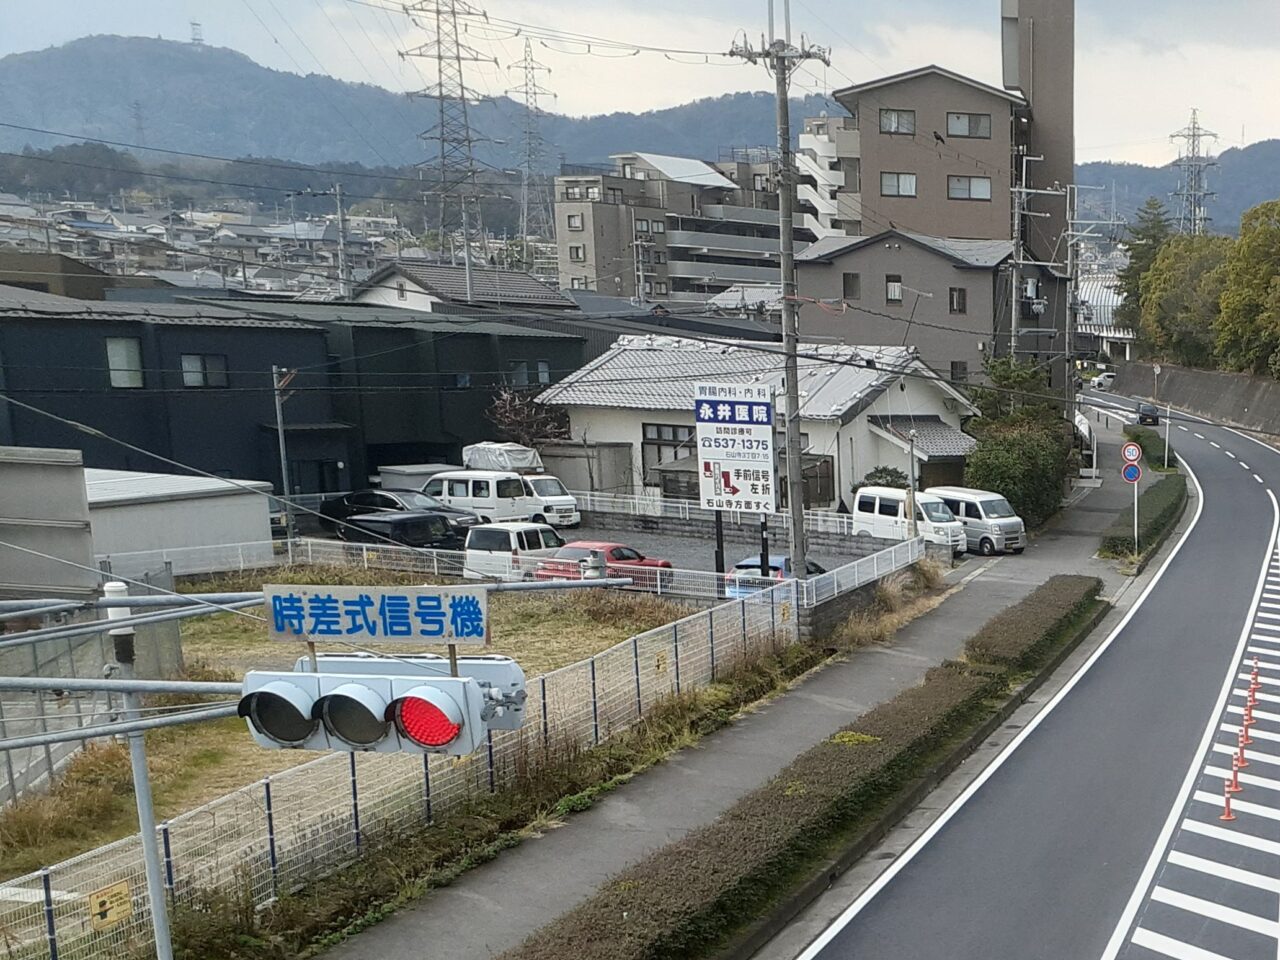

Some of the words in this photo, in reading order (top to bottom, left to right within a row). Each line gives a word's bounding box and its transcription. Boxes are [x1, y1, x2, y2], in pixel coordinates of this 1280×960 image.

[699, 402, 768, 422] 永井医院
[715, 426, 753, 436] 訪問診療可
[713, 437, 769, 451] 537-1375
[1126, 447, 1137, 457] 50
[734, 468, 770, 482] 手前信号
[750, 483, 771, 496] 左折
[706, 498, 770, 511] 石山寺方面すぐ
[271, 592, 485, 638] 時差式信号機
